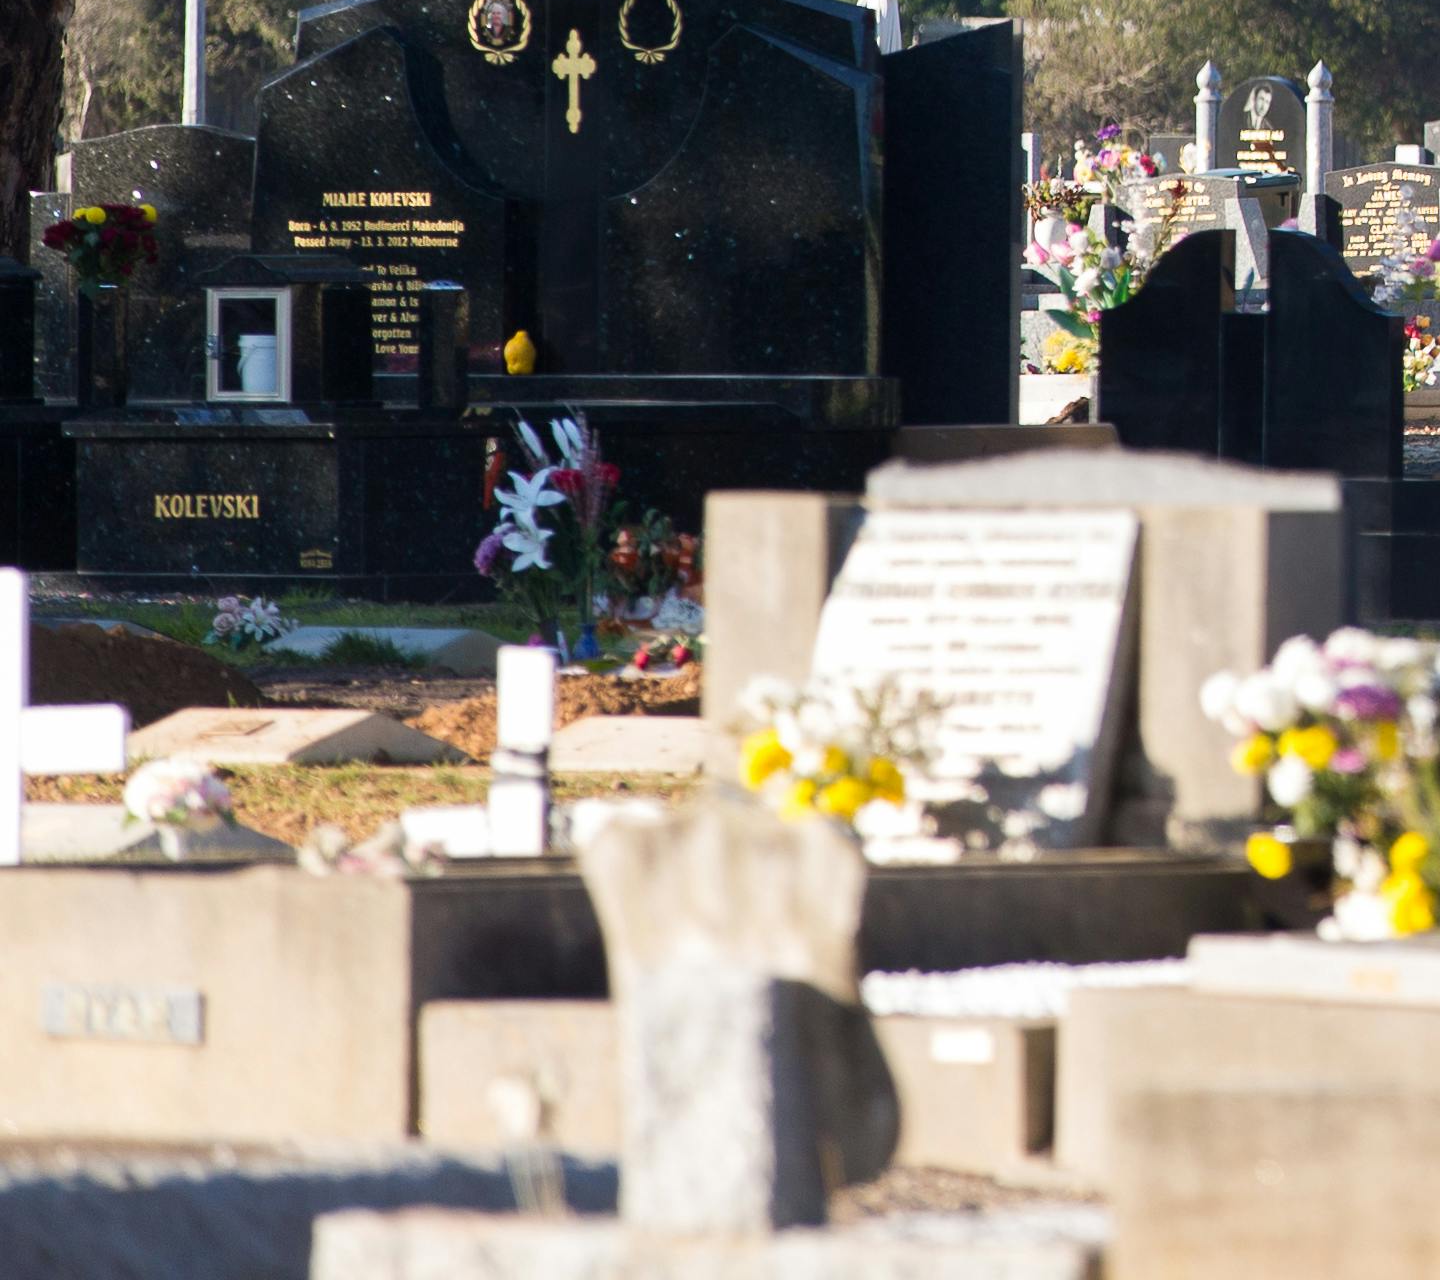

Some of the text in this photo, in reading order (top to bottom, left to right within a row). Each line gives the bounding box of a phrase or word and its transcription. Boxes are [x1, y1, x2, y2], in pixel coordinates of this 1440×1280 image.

[370, 192, 432, 207] KOLEVSKI
[288, 220, 312, 232] Born
[294, 236, 326, 248] Passed
[388, 236, 408, 248] 2012
[410, 236, 458, 248] Melbourne
[389, 265, 417, 276] Velika
[372, 282, 394, 291] avko
[409, 297, 418, 308] Is
[372, 314, 388, 322] ver
[372, 328, 412, 340] orgotten
[154, 494, 260, 518] KOLEVSKI
